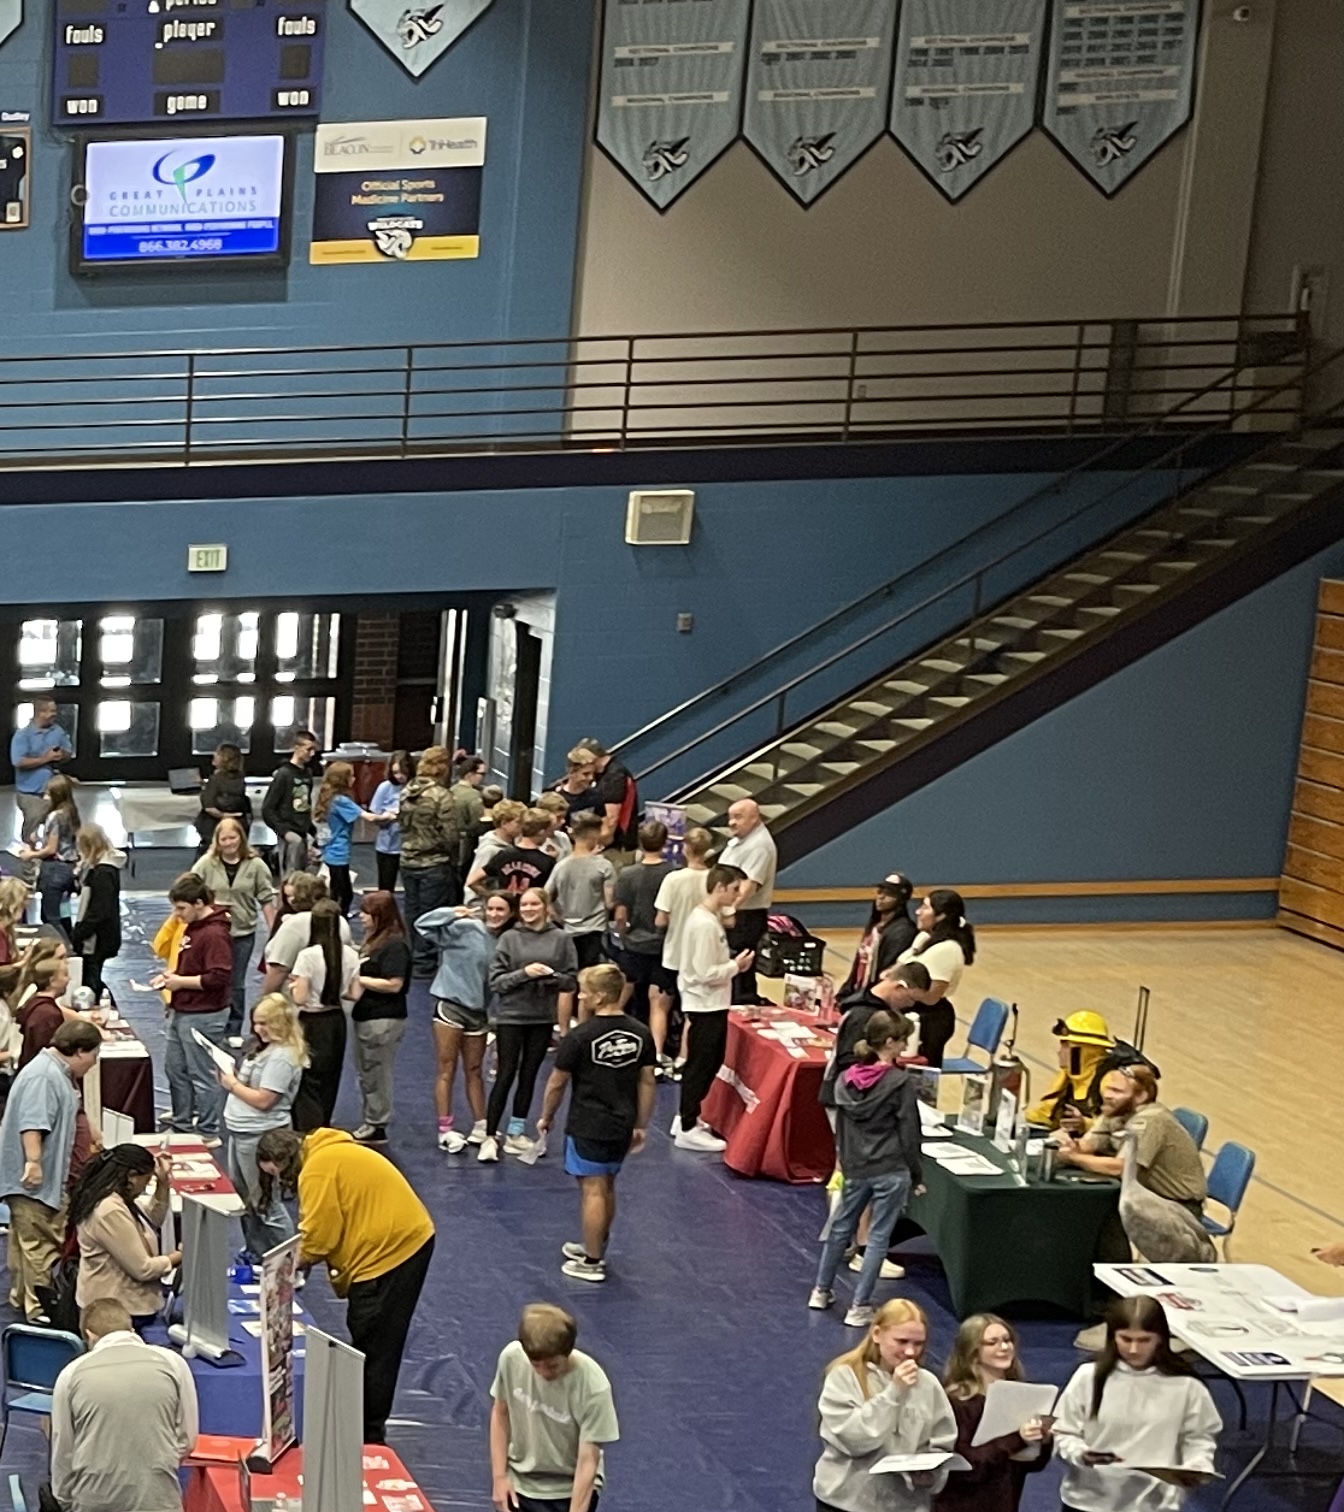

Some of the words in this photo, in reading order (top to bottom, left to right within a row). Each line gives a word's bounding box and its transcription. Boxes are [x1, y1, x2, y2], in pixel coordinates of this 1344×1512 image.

[163, 20, 216, 43] player
[278, 16, 316, 35] fouls
[66, 25, 103, 44] fouls
[66, 98, 98, 114] won
[167, 94, 207, 115] game
[277, 90, 309, 107] won
[428, 139, 478, 150] TriHealth
[109, 190, 164, 201] GREAT
[196, 186, 257, 197] PLAINS
[109, 200, 257, 217] COMMUNICATIONS
[139, 237, 223, 253] 866.382.4968
